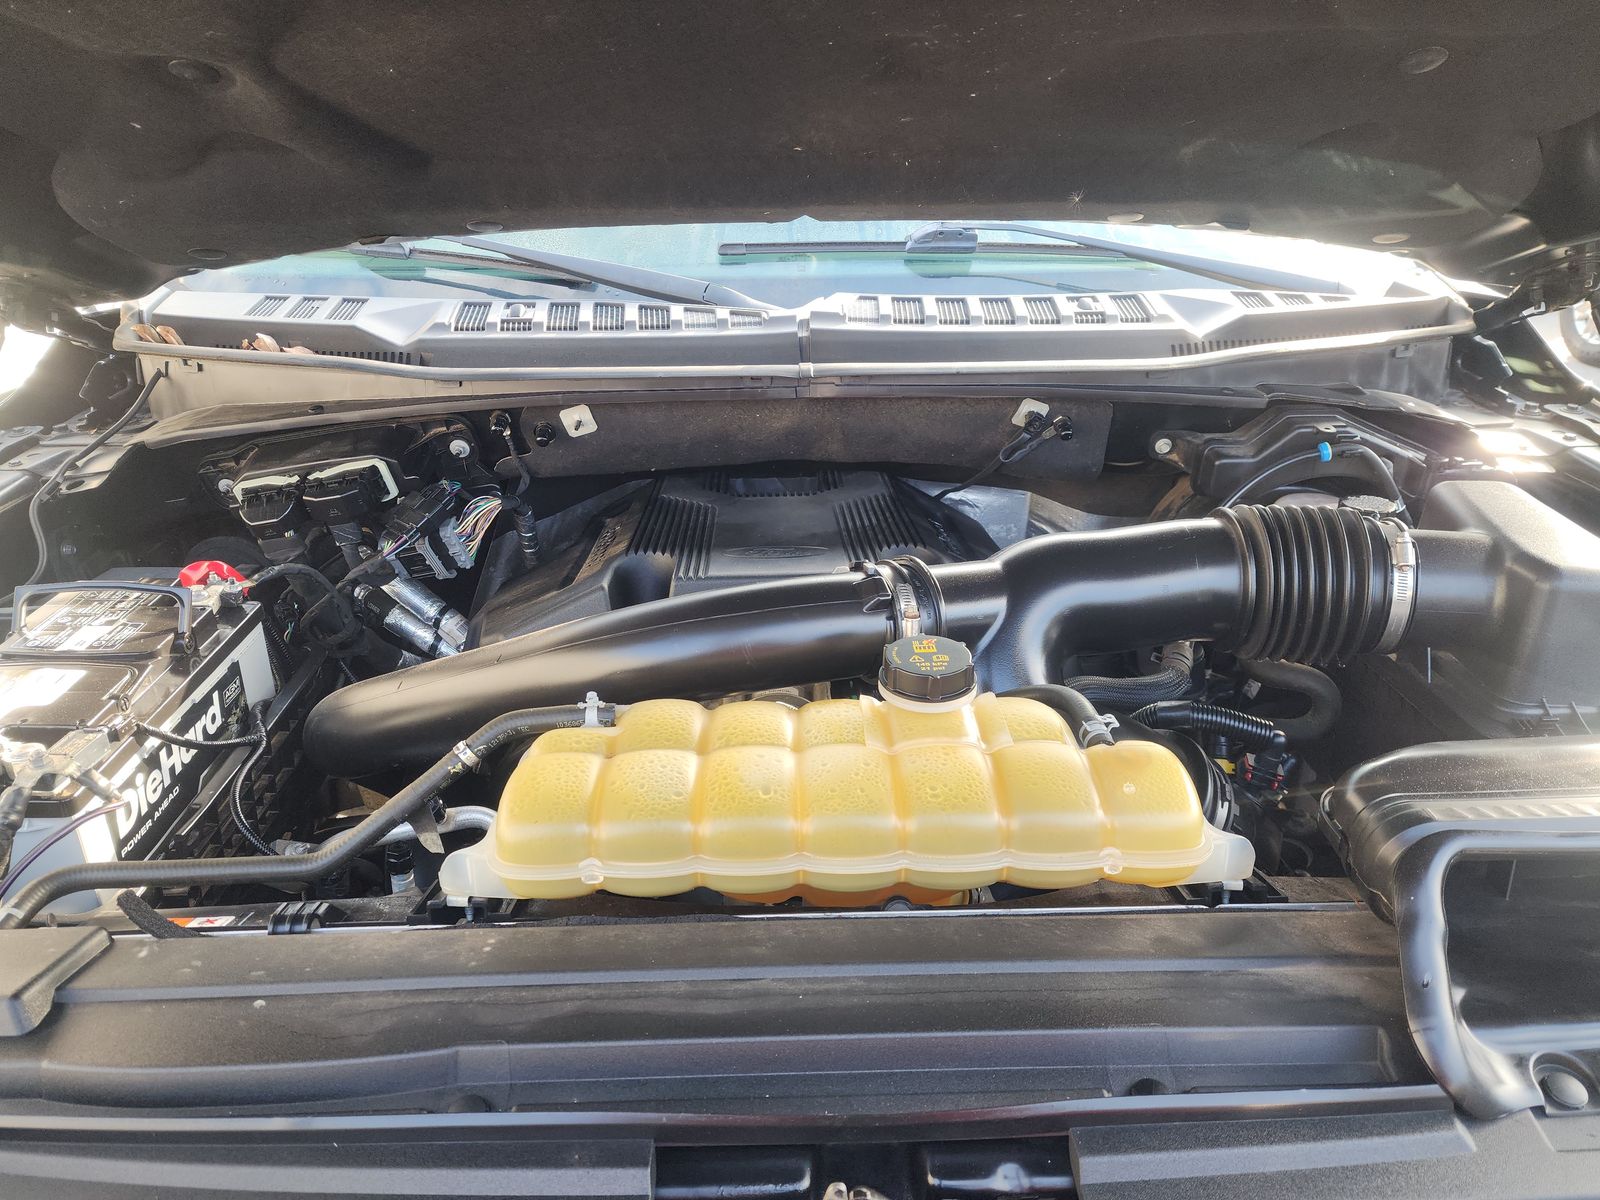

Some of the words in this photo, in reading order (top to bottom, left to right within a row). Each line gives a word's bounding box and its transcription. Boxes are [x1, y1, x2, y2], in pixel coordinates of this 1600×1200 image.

[116, 689, 223, 840] DieHard
[120, 819, 153, 858] POWER
[153, 785, 181, 822] AHEAD
